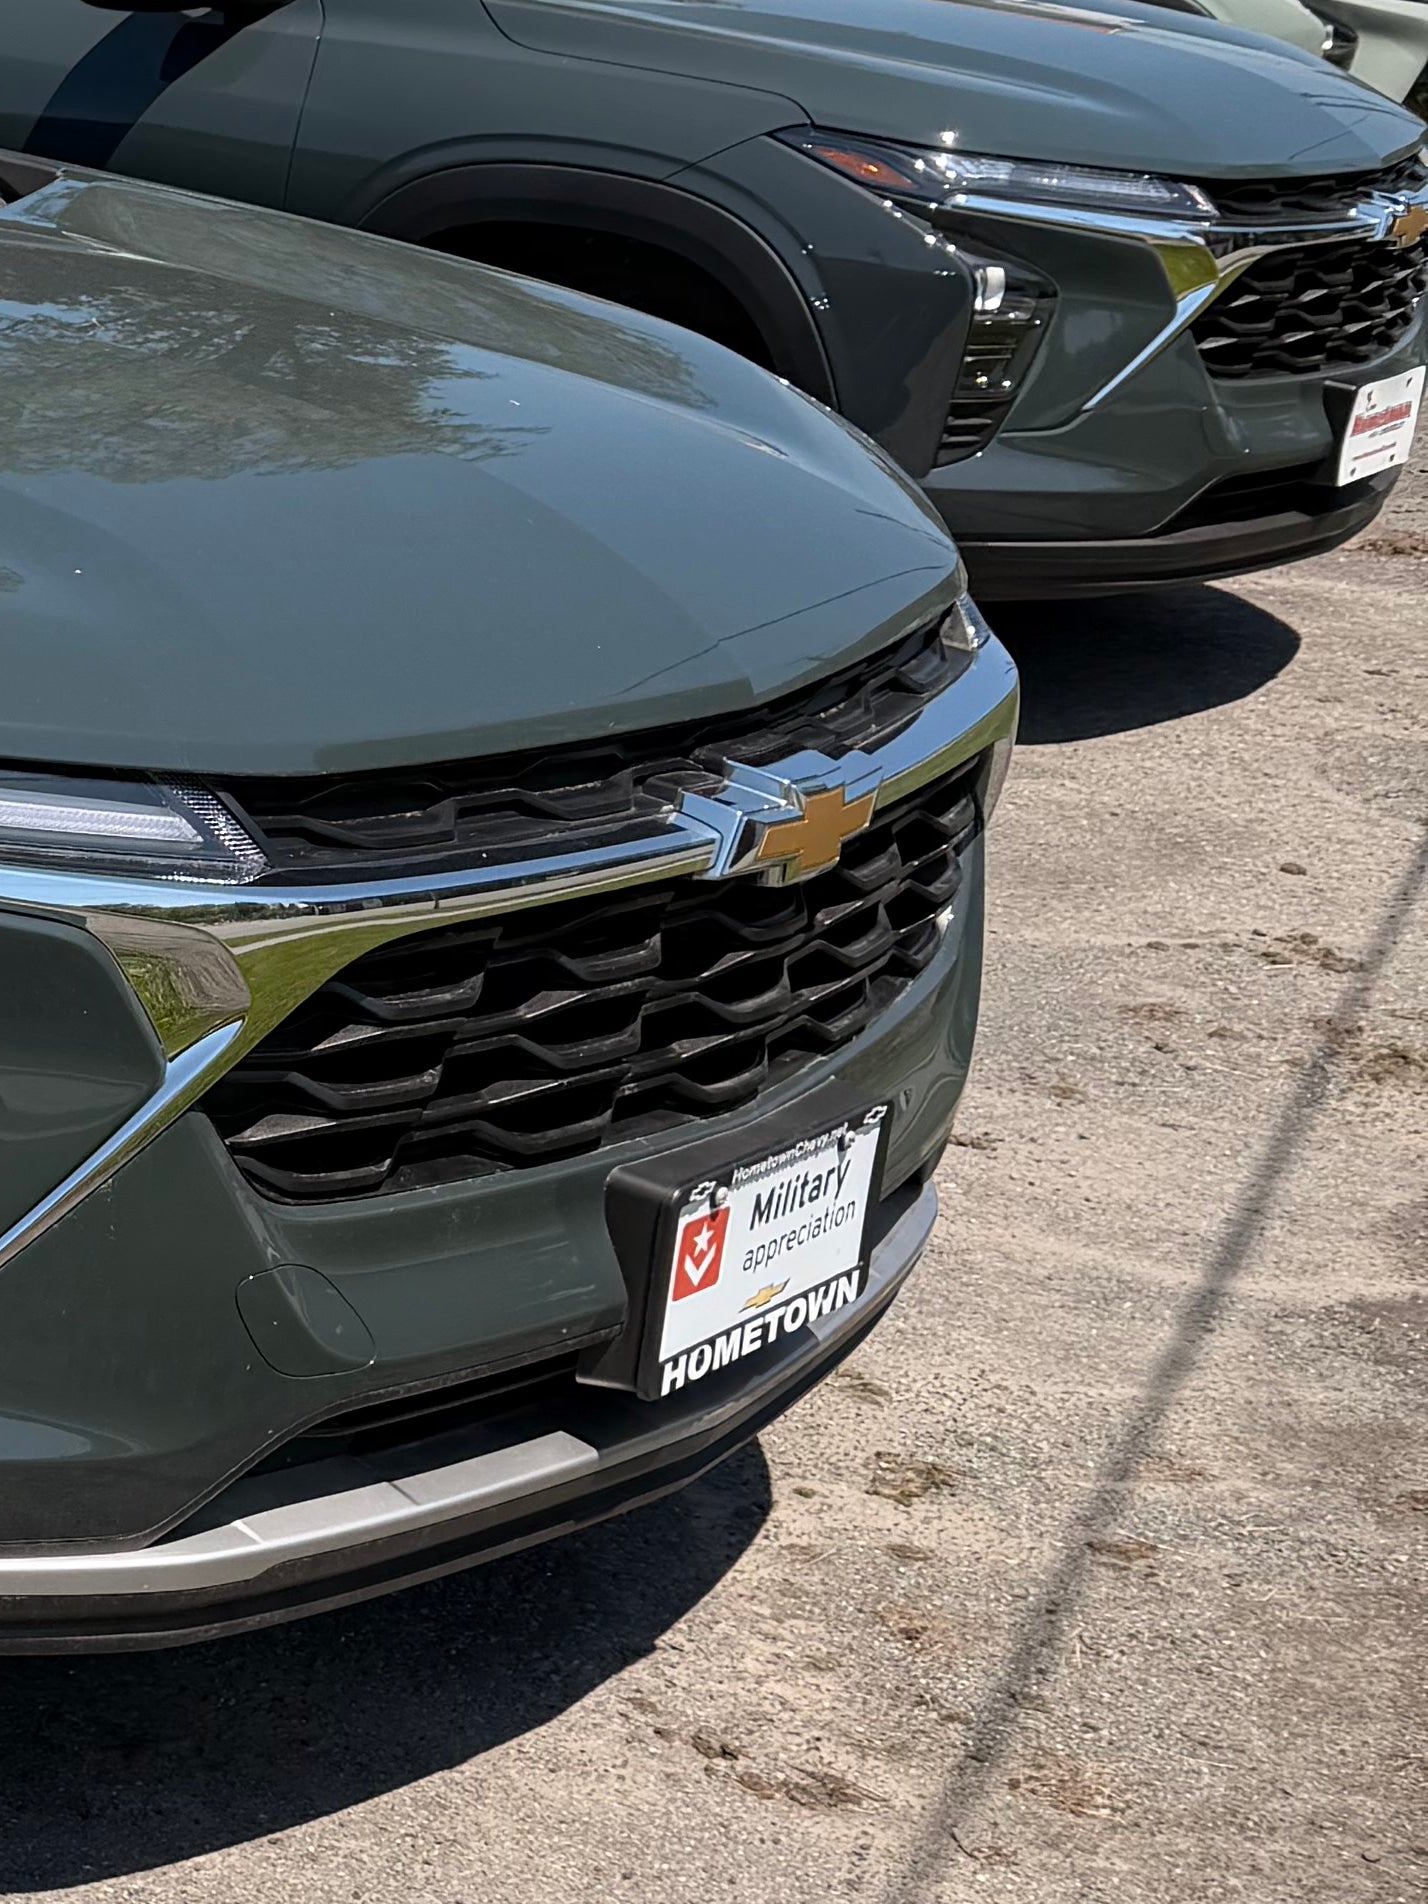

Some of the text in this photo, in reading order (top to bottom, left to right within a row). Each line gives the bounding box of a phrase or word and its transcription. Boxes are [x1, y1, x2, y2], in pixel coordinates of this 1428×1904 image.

[749, 1159, 852, 1231] Military
[742, 1199, 856, 1273] appreciation
[661, 1269, 861, 1397] HOMETOWN
